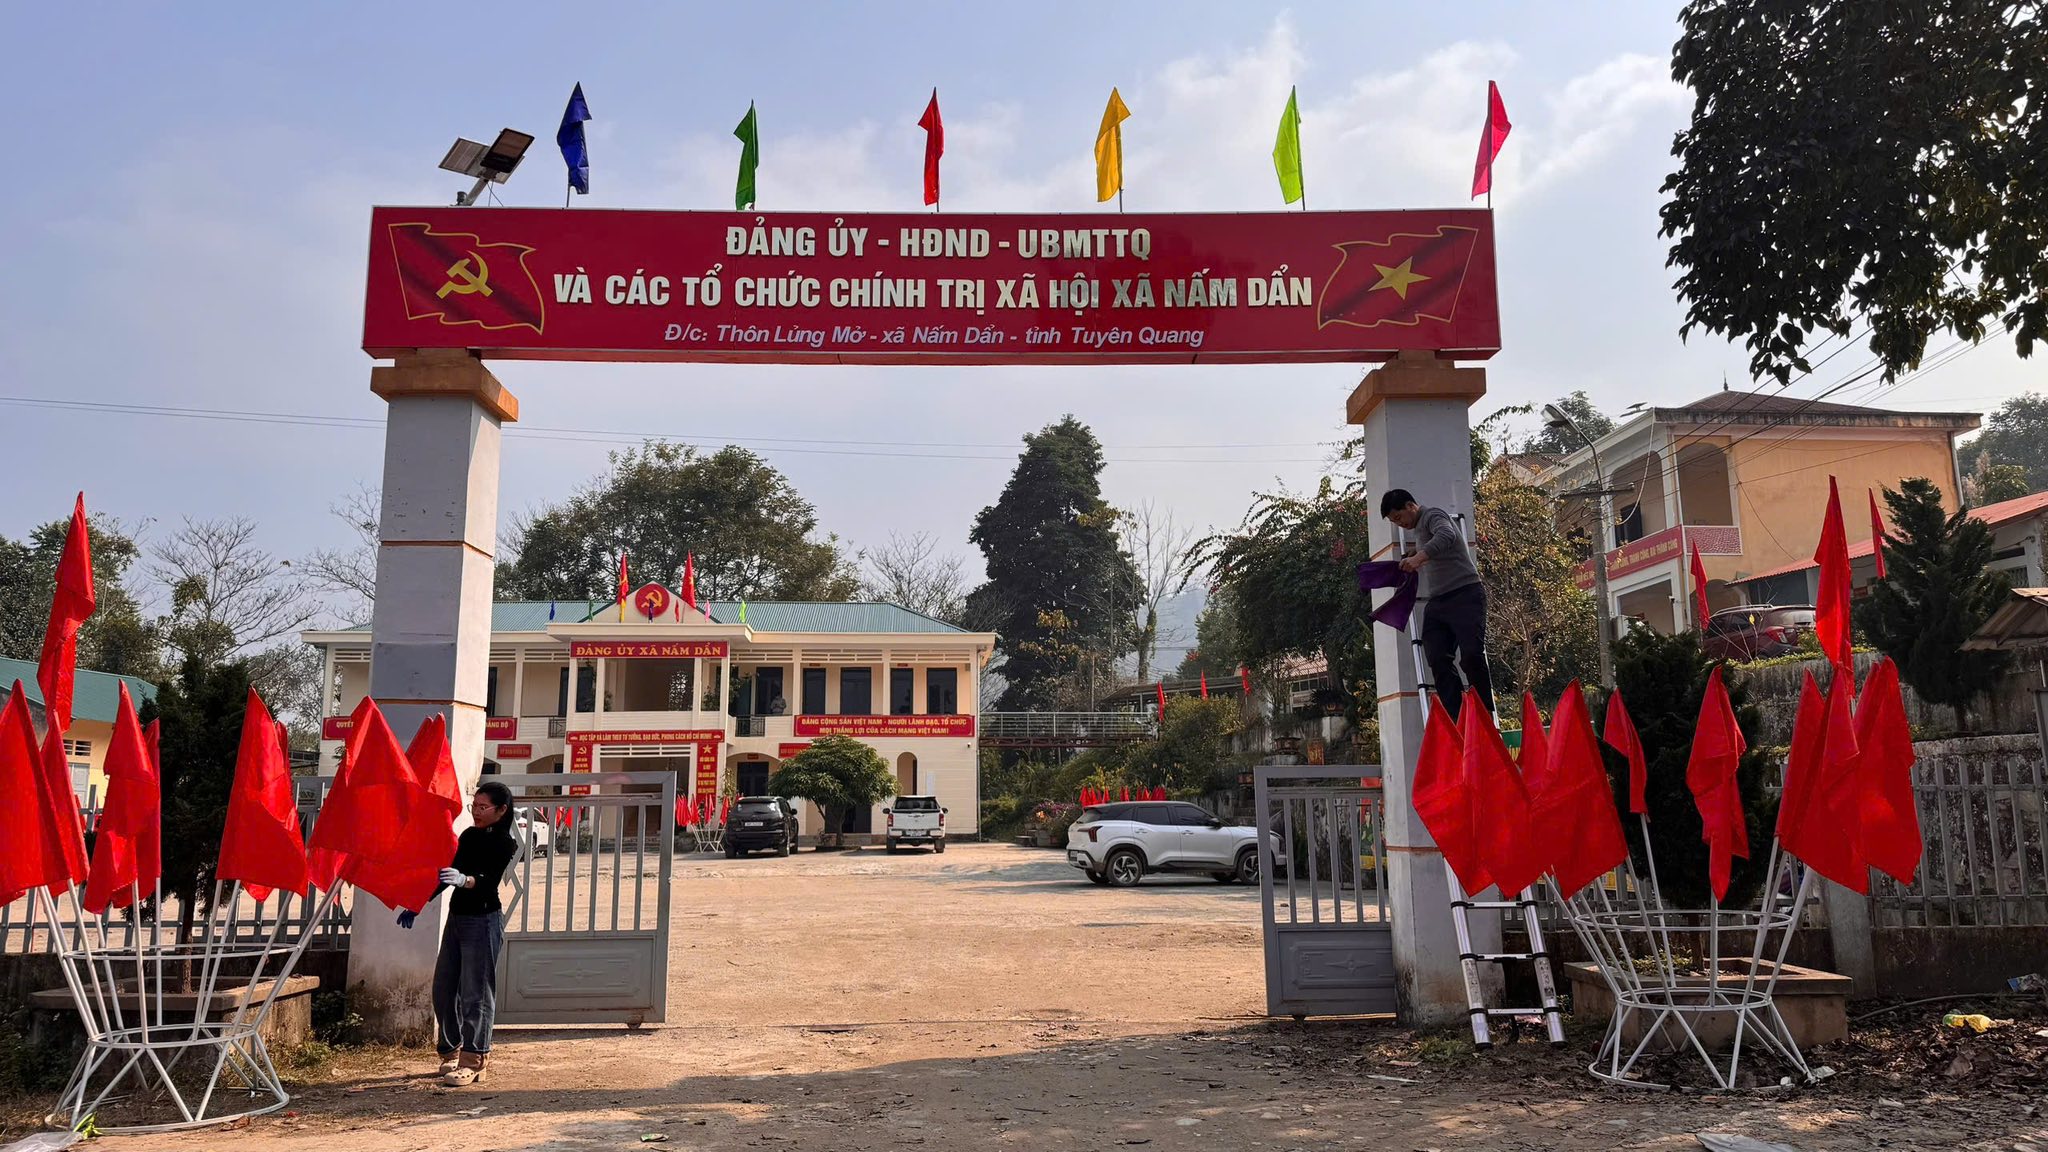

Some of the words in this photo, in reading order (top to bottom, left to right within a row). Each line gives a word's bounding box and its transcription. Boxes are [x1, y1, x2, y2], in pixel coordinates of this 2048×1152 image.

[726, 216, 816, 256] ĐẢNG
[828, 218, 868, 257] ỦY
[900, 228, 990, 257] HĐND
[1018, 228, 1151, 260] UBMTTQ
[553, 267, 592, 303] VÀ
[605, 268, 670, 306] CÁC
[682, 263, 723, 306] TỔ
[734, 270, 820, 307] CHỨC
[829, 271, 926, 308] CHÍNH
[936, 279, 985, 315] TRỊ
[995, 273, 1040, 308] XÃ
[1049, 272, 1099, 316] HỘI
[1112, 273, 1155, 308] XÃ
[1164, 268, 1238, 308] NẤM
[1247, 264, 1312, 306] DẨN
[664, 324, 707, 342] Đ/c:
[716, 325, 769, 343] Thôn
[774, 326, 825, 347] Lủng
[831, 326, 865, 344] Mở
[881, 327, 905, 344] xã
[912, 325, 958, 344] Nấm
[964, 325, 1004, 344] Dẩn
[1025, 327, 1061, 344] tỉnh
[1071, 327, 1132, 348] Tuyên
[1138, 327, 1204, 347] Quang
[576, 644, 612, 656] ĐẢNG
[617, 644, 635, 656] ỦY
[639, 645, 658, 656] XÃ
[662, 643, 690, 656] NẤM
[801, 717, 819, 725] ĐẢNG
[820, 718, 838, 726] CỘNG
[853, 718, 866, 726] VIỆT
[950, 718, 967, 726] CHỨC
[866, 726, 879, 734] CỦA
[918, 727, 931, 735] VIỆT
